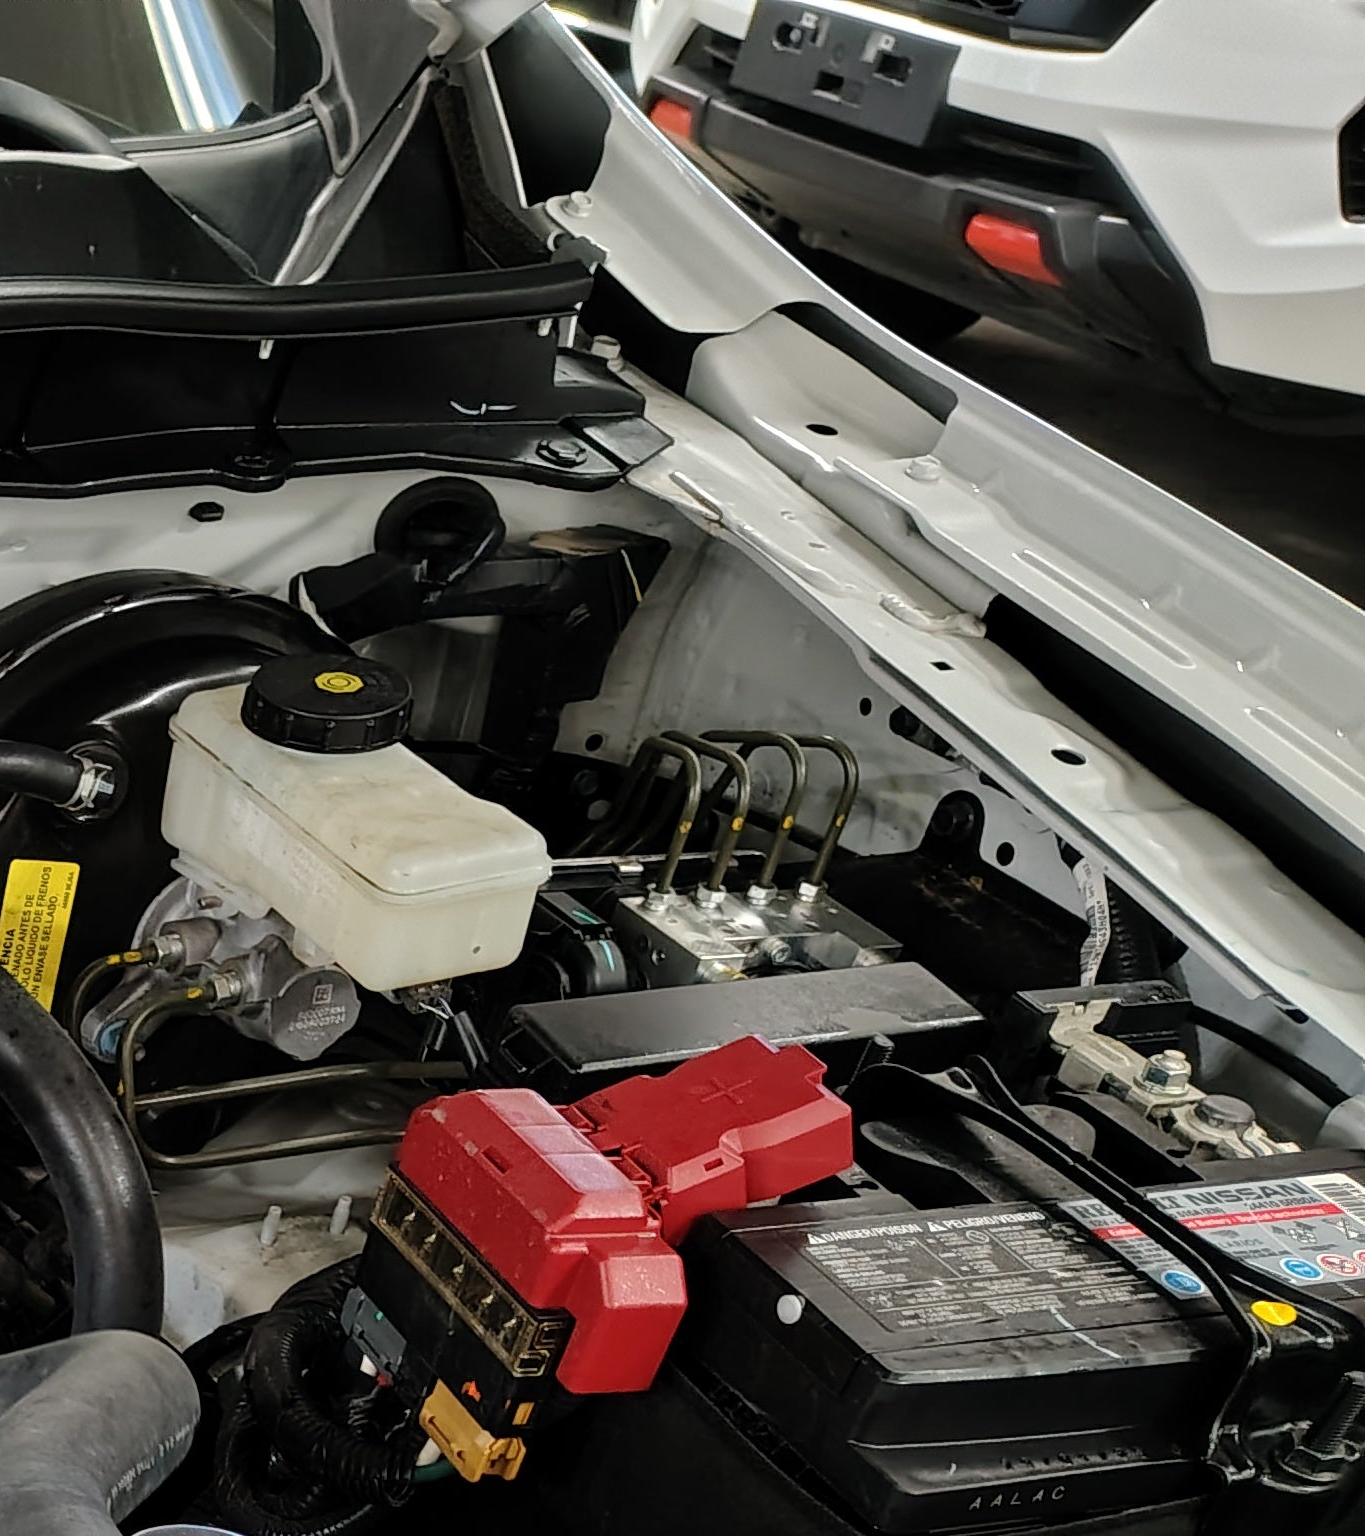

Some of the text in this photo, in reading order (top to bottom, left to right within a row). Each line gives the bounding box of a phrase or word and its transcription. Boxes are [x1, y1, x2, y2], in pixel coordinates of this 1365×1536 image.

[25, 894, 35, 907] DE
[20, 910, 32, 942] ANTES
[21, 866, 52, 988] OLO LIQUIDO DE FRENOS
[34, 944, 48, 985] ENVASE
[1183, 1183, 1312, 1208] NISSAN
[823, 1222, 923, 1244] DANGER/POISON
[942, 1210, 1046, 1231] PELIGRO/VENENO
